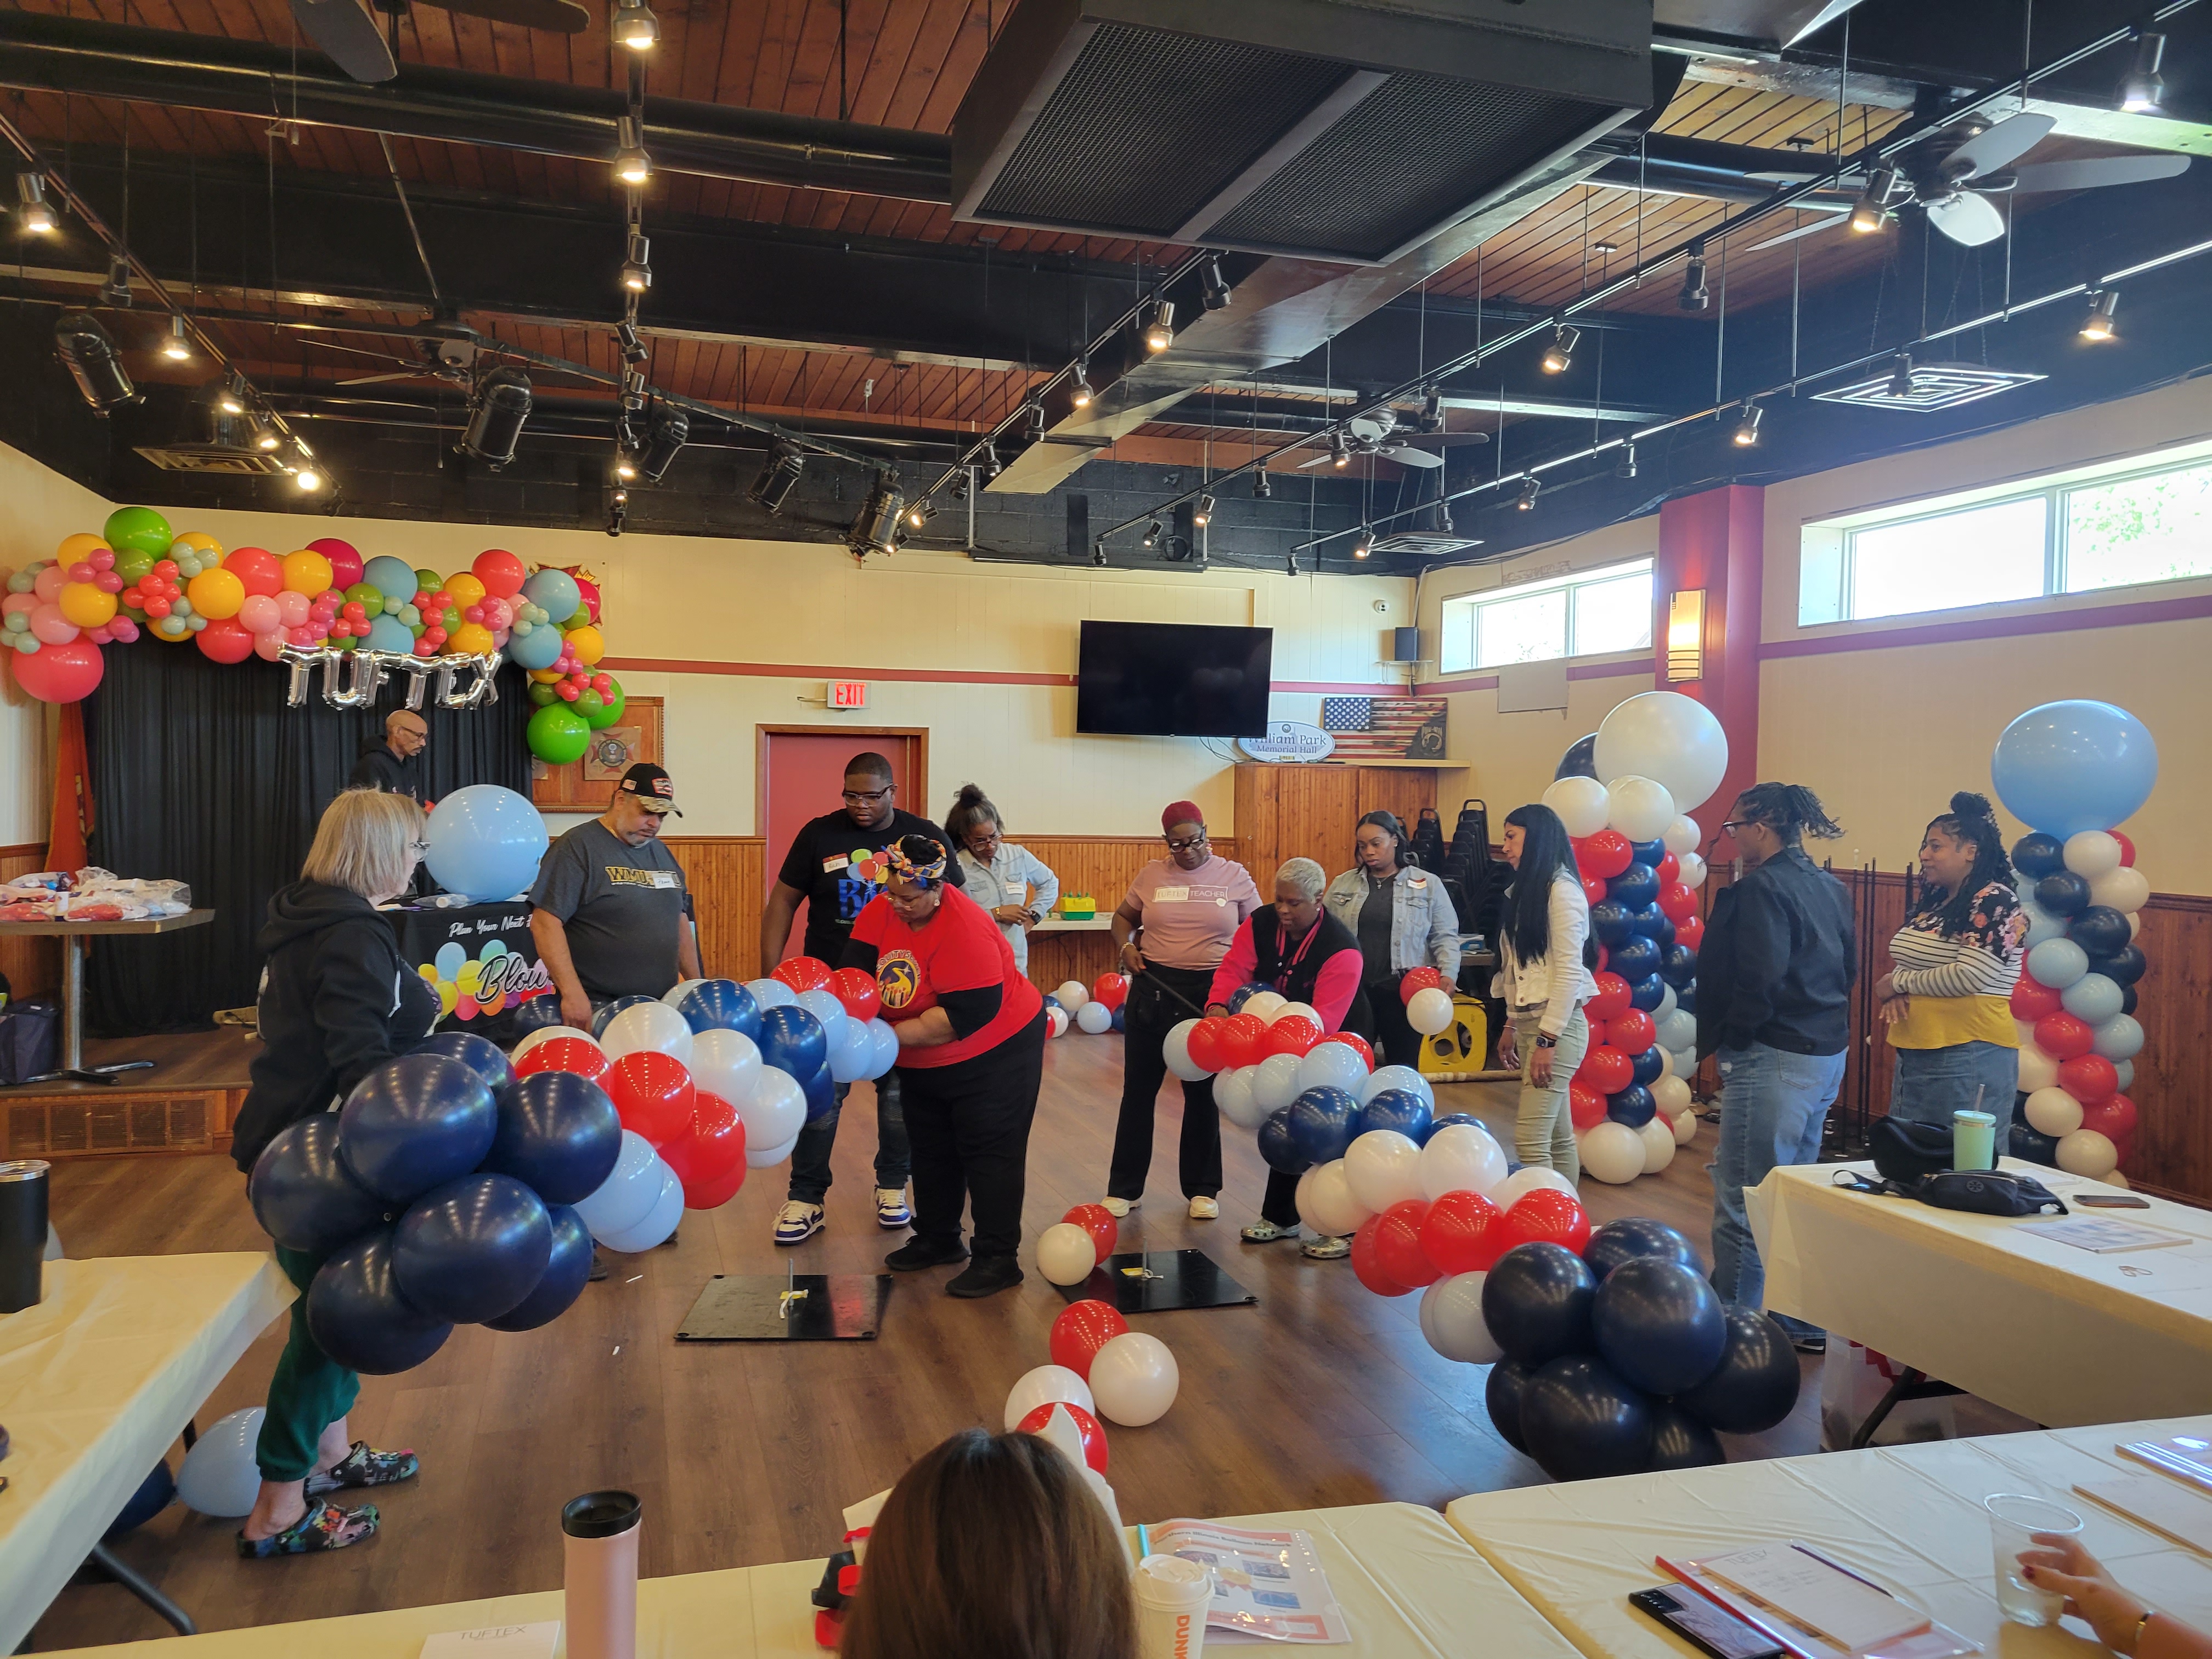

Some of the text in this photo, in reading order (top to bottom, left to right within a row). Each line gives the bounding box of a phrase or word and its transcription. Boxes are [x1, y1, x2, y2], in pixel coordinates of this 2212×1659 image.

[835, 681, 866, 706] EXIT
[1300, 734, 1327, 746] Park
[1257, 745, 1296, 753] Memorial
[448, 922, 473, 938] Plan
[476, 919, 499, 935] Your
[500, 915, 525, 932] Next
[460, 1626, 527, 1640] TUFTEX
